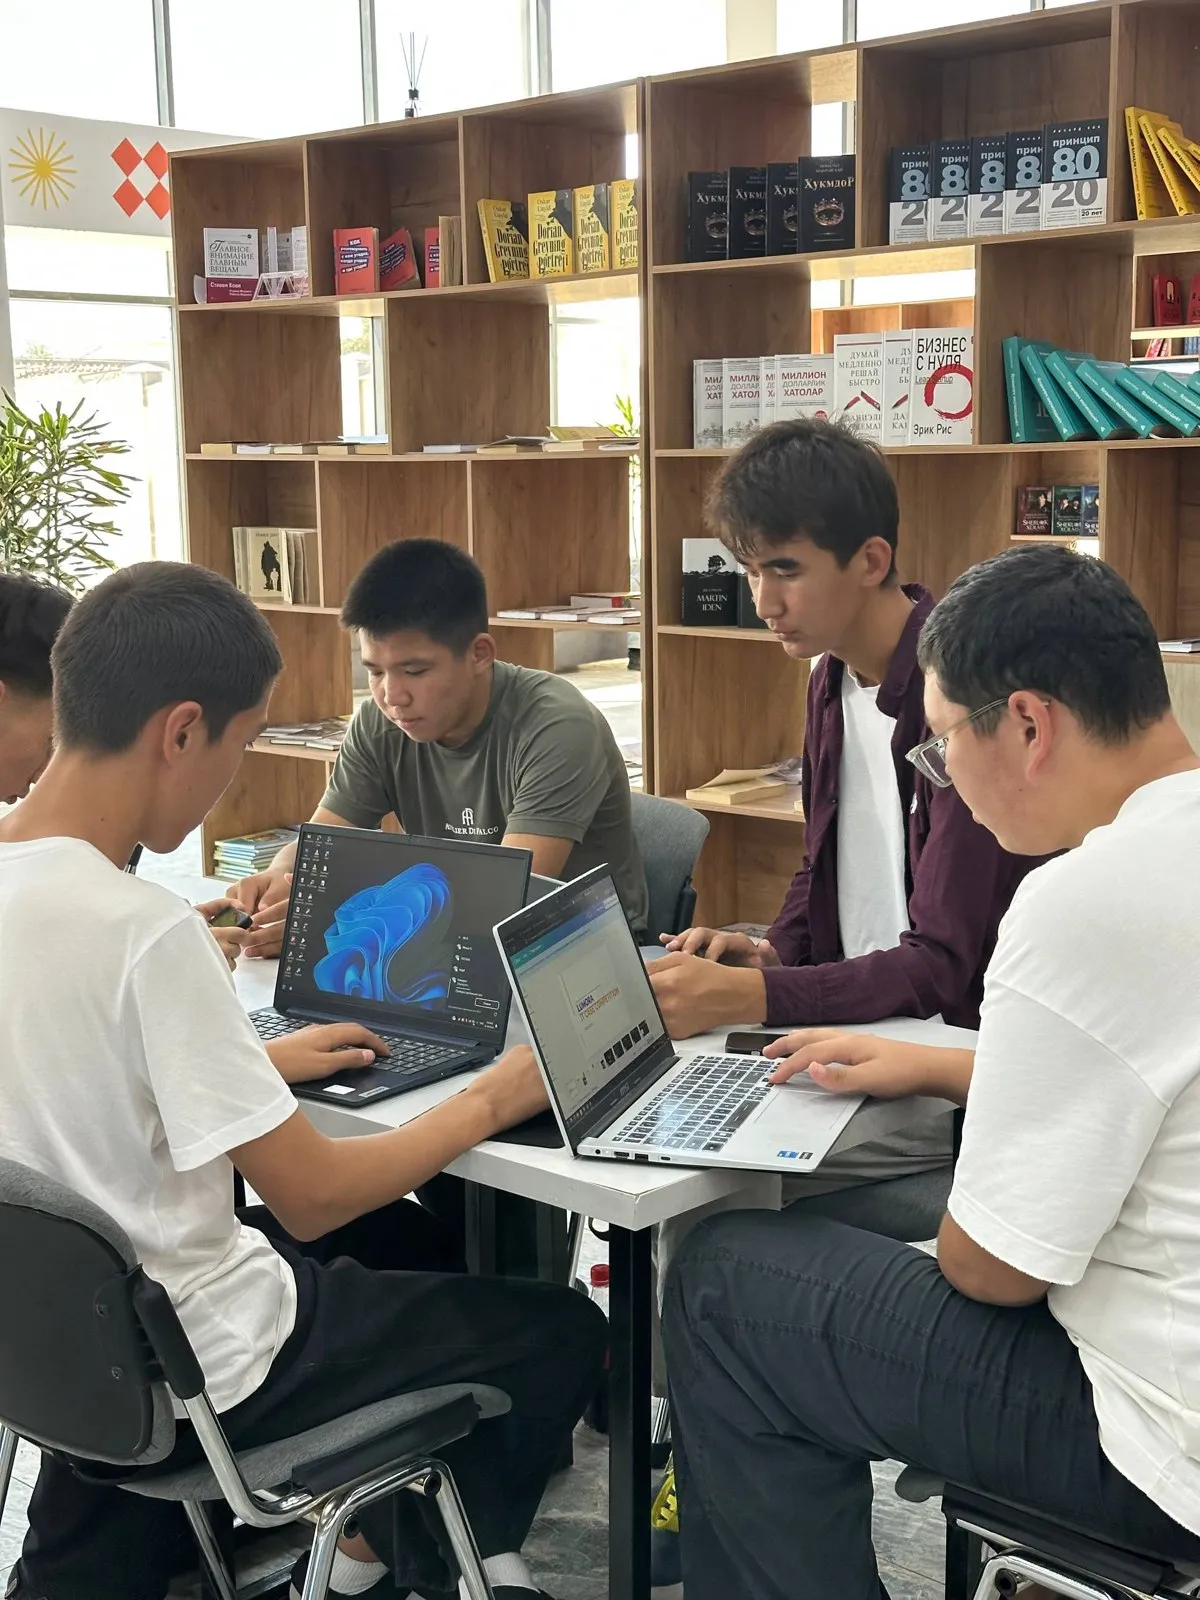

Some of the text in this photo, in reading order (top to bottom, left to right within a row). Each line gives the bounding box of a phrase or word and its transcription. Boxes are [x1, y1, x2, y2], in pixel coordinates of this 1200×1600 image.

[1053, 135, 1100, 149] принцип
[1051, 144, 1100, 181] 80
[1051, 179, 1099, 209] 20
[537, 223, 562, 239] Dorian
[580, 218, 600, 236] Dorian
[209, 240, 250, 252] ГЛАВНОЕ
[210, 252, 255, 260] ВНИМАНИЕ
[210, 259, 248, 267] ГЛАВНЫМ
[210, 265, 239, 274] ВЕЩАМ
[917, 337, 967, 354] БИЗНЕС
[849, 349, 879, 360] ДУМАЙ
[838, 359, 882, 369] МЕДЛЕННО
[916, 355, 924, 371] С
[781, 371, 827, 380] МИЛЛИОН
[850, 368, 879, 377] РЕШАЙ
[782, 379, 825, 388] ДОЛЛАРЛИК
[849, 378, 881, 387] БЫСТРО
[784, 388, 824, 397] ХАТОЛАР
[913, 424, 952, 437] Эрик Рис
[696, 594, 727, 602] MARTIN
[702, 603, 722, 612] IDEN
